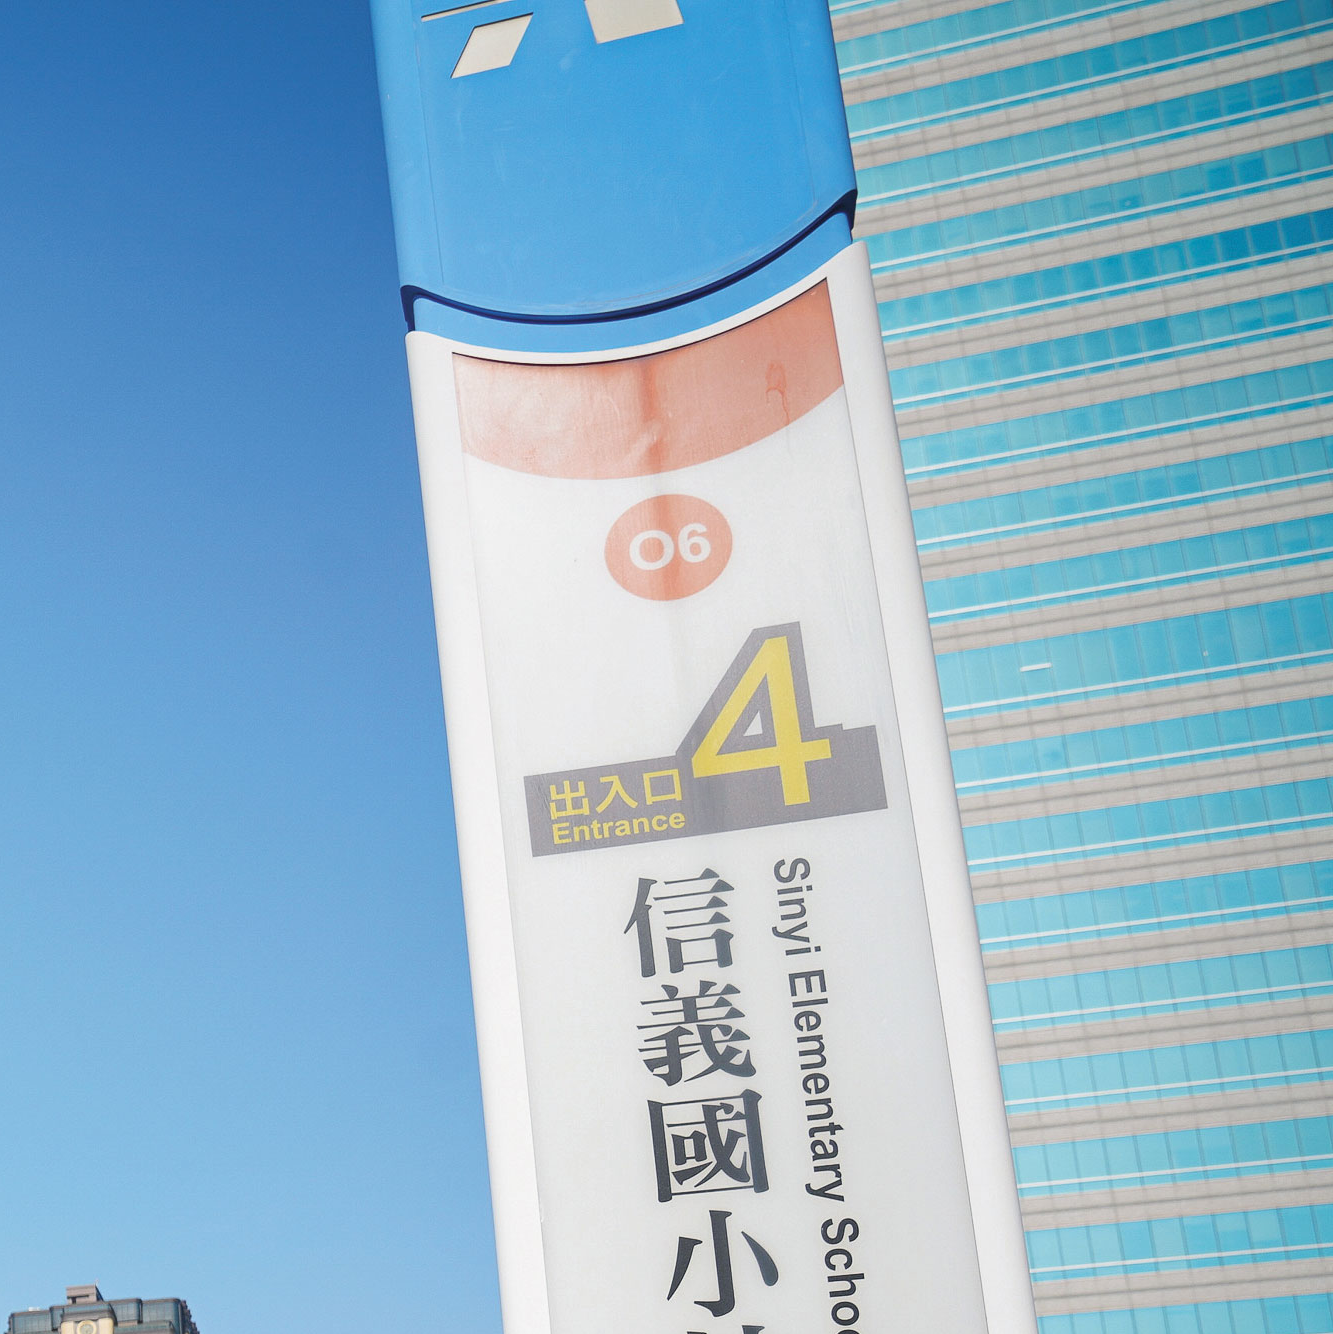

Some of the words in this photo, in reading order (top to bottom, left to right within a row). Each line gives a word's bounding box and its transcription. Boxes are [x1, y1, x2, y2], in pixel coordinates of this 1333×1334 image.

[628, 522, 712, 572] O6
[690, 635, 832, 806] 4
[548, 767, 684, 821] 出入口
[551, 809, 686, 846] Entrance
[771, 856, 821, 957] Sinyi
[787, 968, 846, 1203] Elementary
